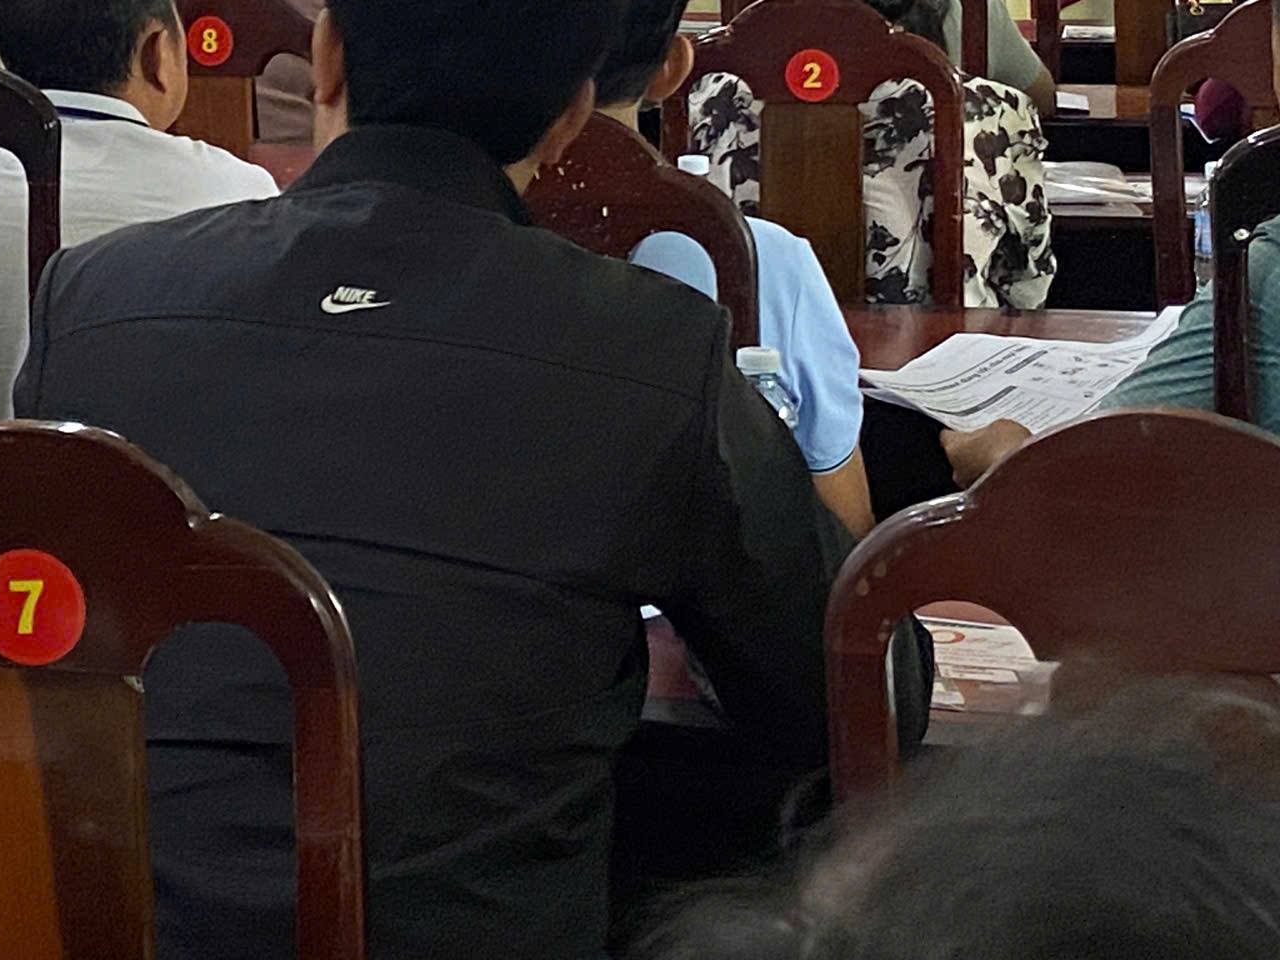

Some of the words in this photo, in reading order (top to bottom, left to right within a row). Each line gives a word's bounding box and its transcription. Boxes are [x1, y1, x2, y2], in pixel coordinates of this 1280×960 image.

[201, 28, 218, 54] 8
[803, 62, 822, 89] 2
[333, 286, 377, 304] NIKE
[8, 580, 44, 635] 7
